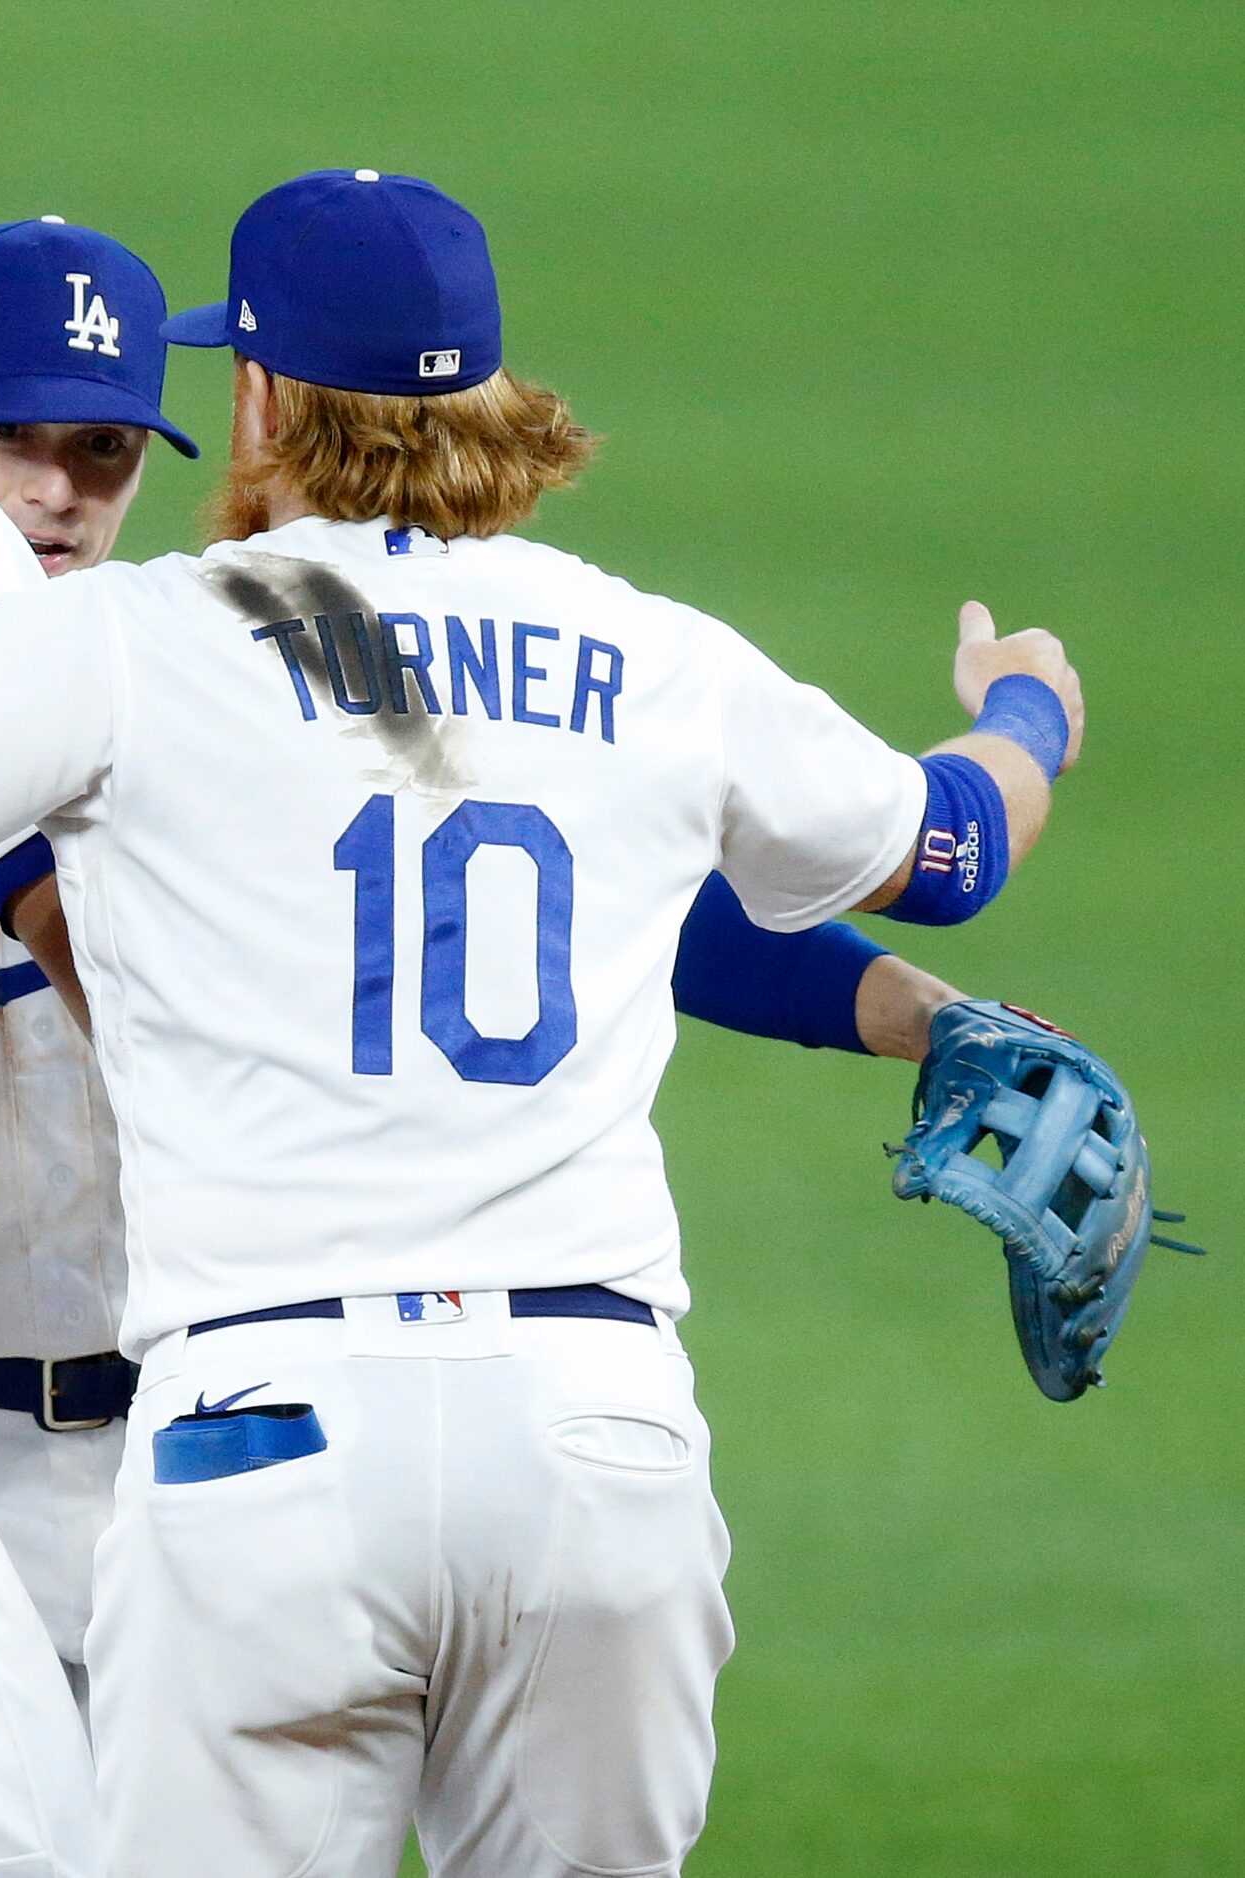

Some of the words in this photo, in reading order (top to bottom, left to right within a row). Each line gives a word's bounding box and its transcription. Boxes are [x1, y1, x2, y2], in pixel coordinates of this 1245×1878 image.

[64, 273, 120, 358] LA
[250, 611, 625, 745] TURNER
[921, 829, 956, 873] 10
[962, 820, 980, 893] adidas
[333, 794, 579, 1087] 10
